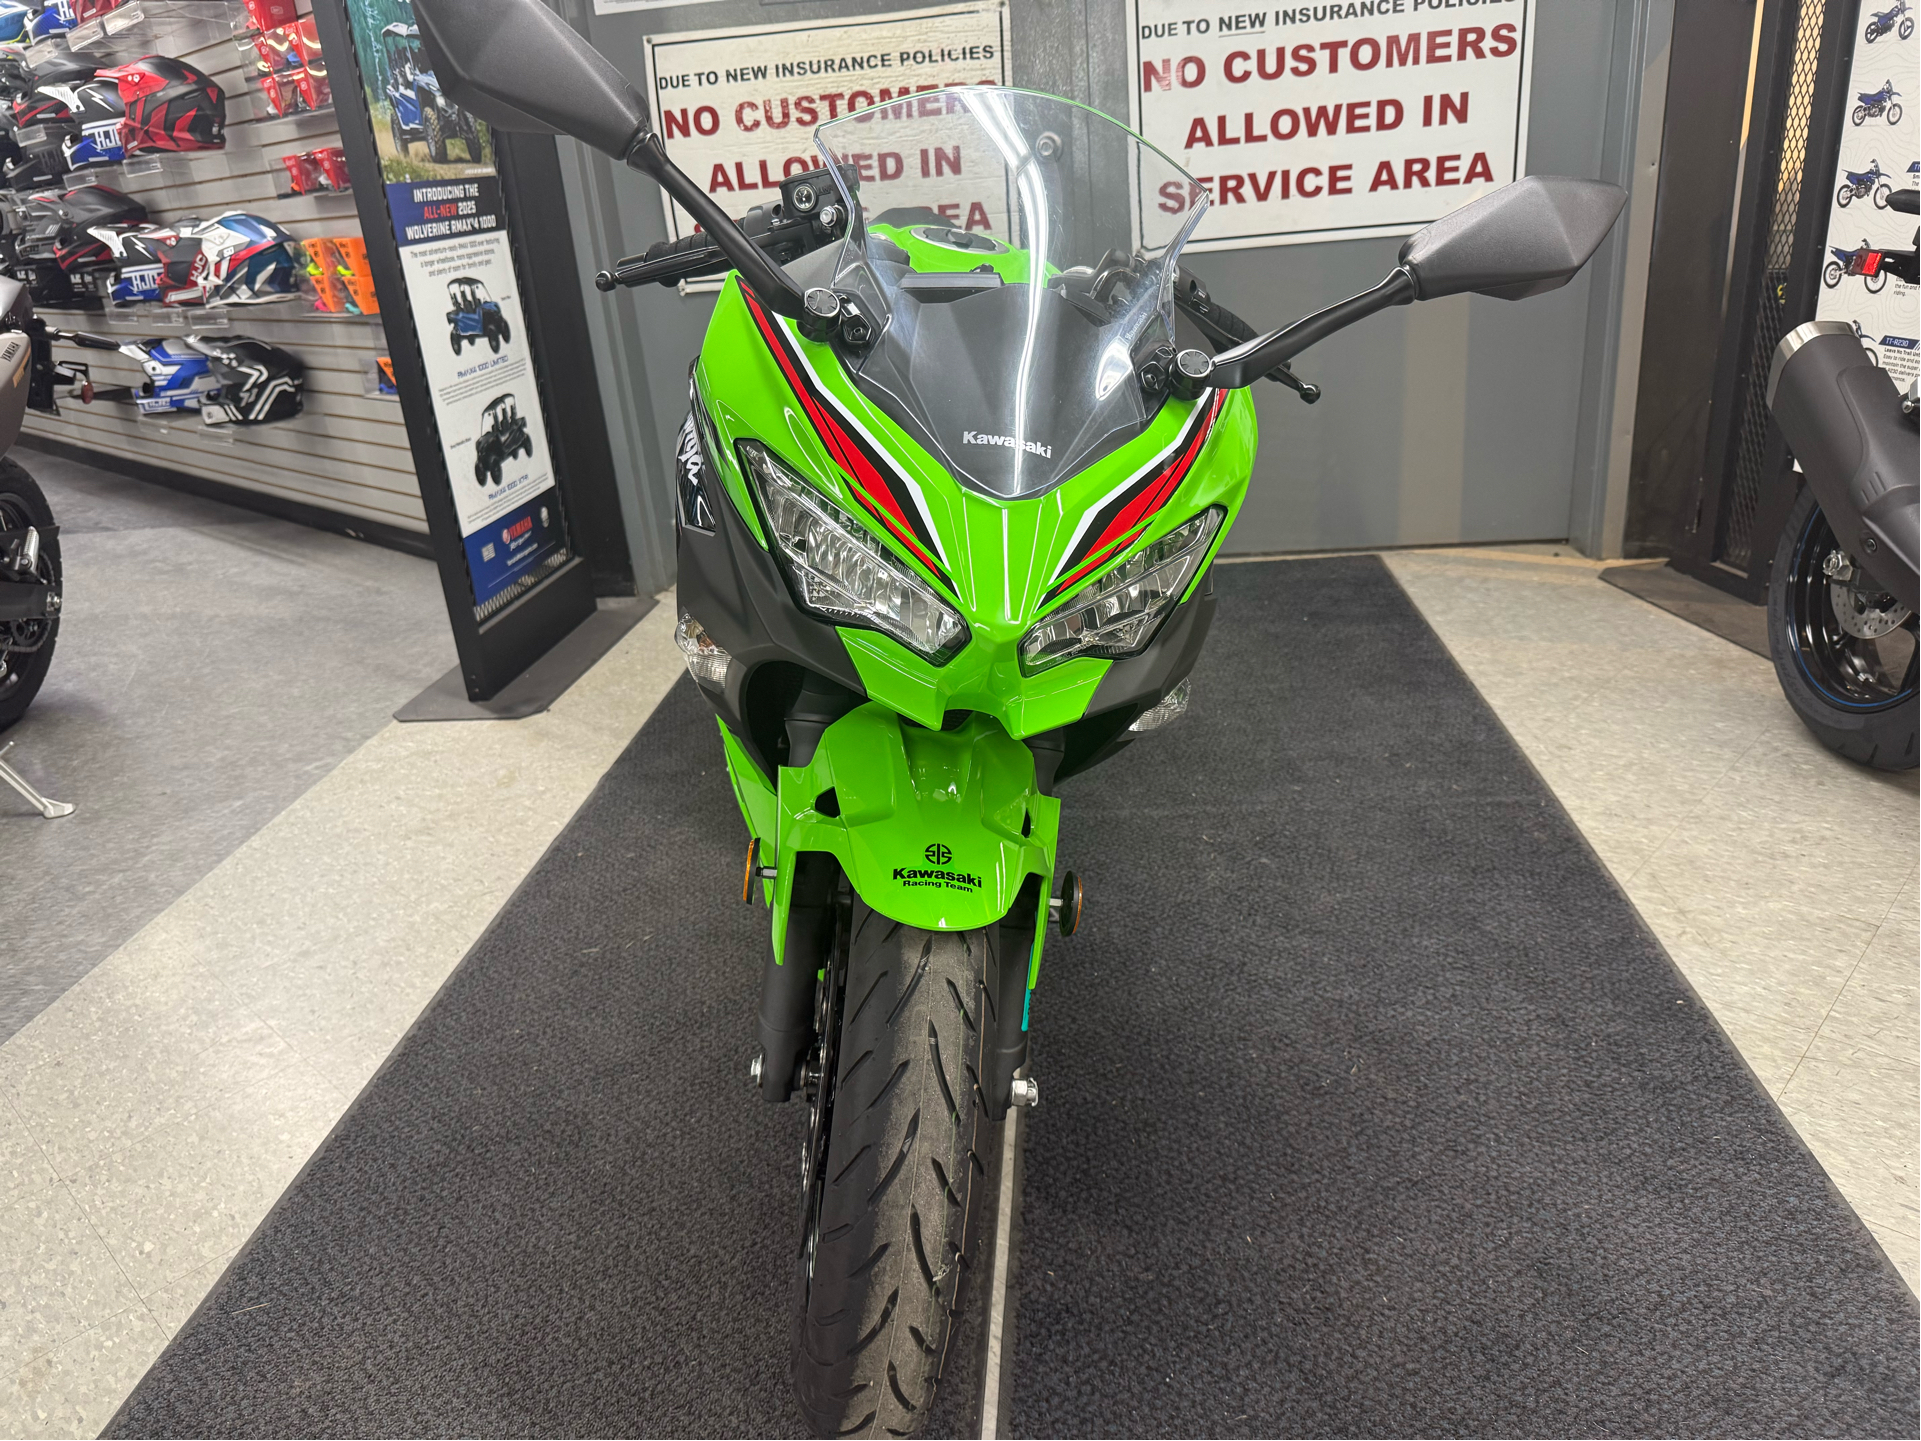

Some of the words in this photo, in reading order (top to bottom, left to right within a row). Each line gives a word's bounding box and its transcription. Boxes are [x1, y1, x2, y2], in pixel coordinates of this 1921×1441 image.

[1141, 22, 1179, 40] DUE
[1183, 19, 1211, 36] TO
[1218, 12, 1266, 33] NEW
[1274, 0, 1405, 27] INSURANCE
[1413, 0, 1515, 11] POLI
[659, 75, 691, 90] DUE
[695, 71, 719, 86] TO
[726, 65, 768, 84] NEW
[775, 53, 892, 78] INSURANCE
[900, 45, 994, 66] POLICIES
[1142, 56, 1206, 93] NO
[1223, 23, 1517, 83] CUSTOMERS
[664, 106, 720, 139] NO
[735, 80, 998, 132] CUSTOMER
[1184, 99, 1404, 150] ALLOWED
[1422, 91, 1469, 127] IN
[920, 145, 961, 178] IN
[413, 185, 465, 203] INTRODUCING
[464, 183, 479, 197] THE
[1158, 164, 1353, 215] SERVICE
[1368, 152, 1494, 193] AREA
[424, 203, 457, 219] ALL-NEW
[458, 200, 476, 215] 2025
[405, 221, 450, 240] WOLVERINE
[480, 214, 496, 229] 1000
[190, 254, 206, 281] HJC
[1886, 338, 1908, 346] TT-R230
[893, 867, 982, 888] Kawasaki
[903, 880, 941, 888] Racing
[944, 881, 973, 893] Team
